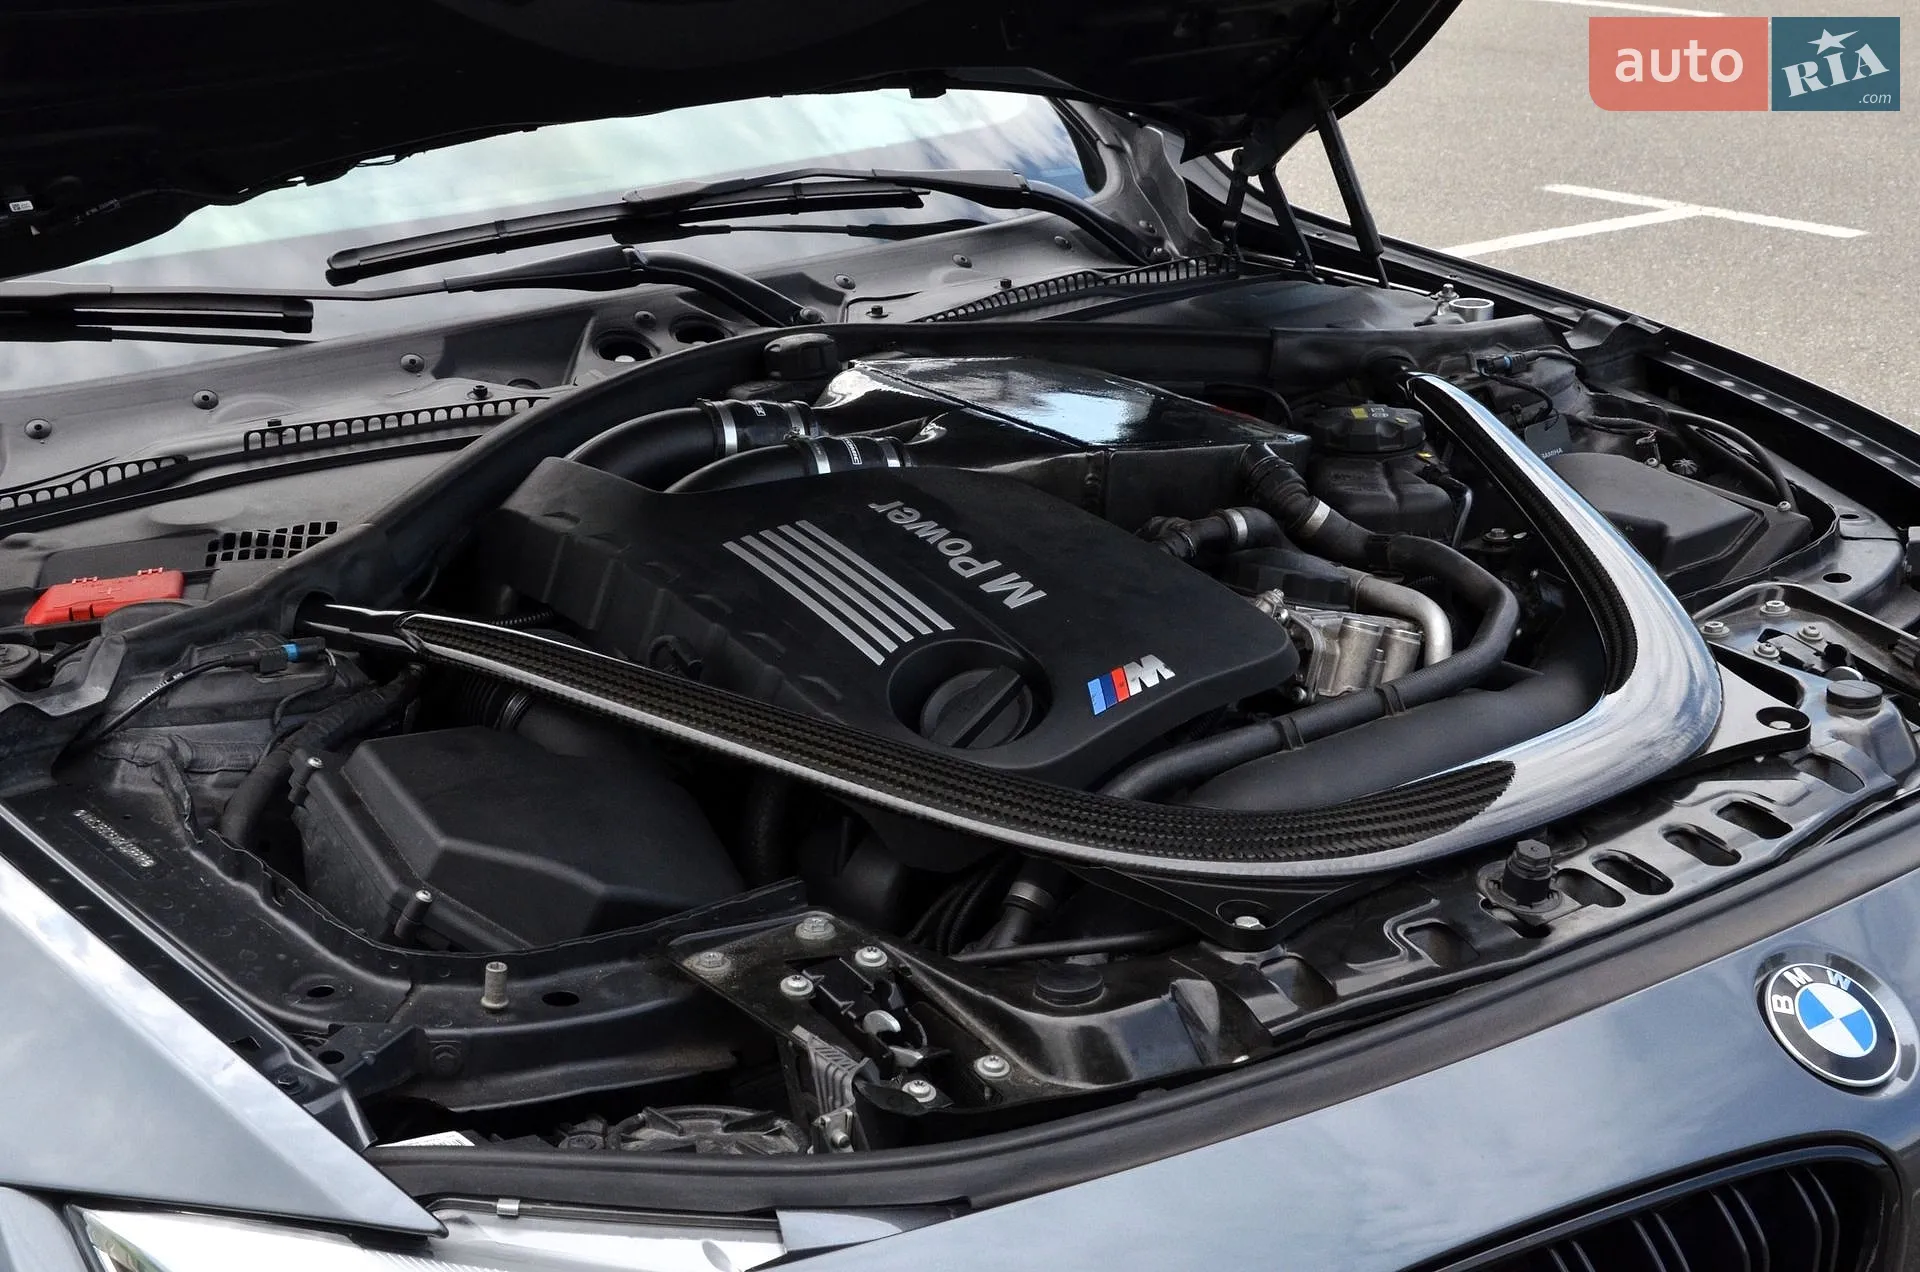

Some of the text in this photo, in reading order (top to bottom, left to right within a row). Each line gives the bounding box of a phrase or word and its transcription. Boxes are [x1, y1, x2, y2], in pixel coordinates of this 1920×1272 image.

[868, 500, 1047, 609] M Power
[1771, 966, 1852, 1016] BMW
